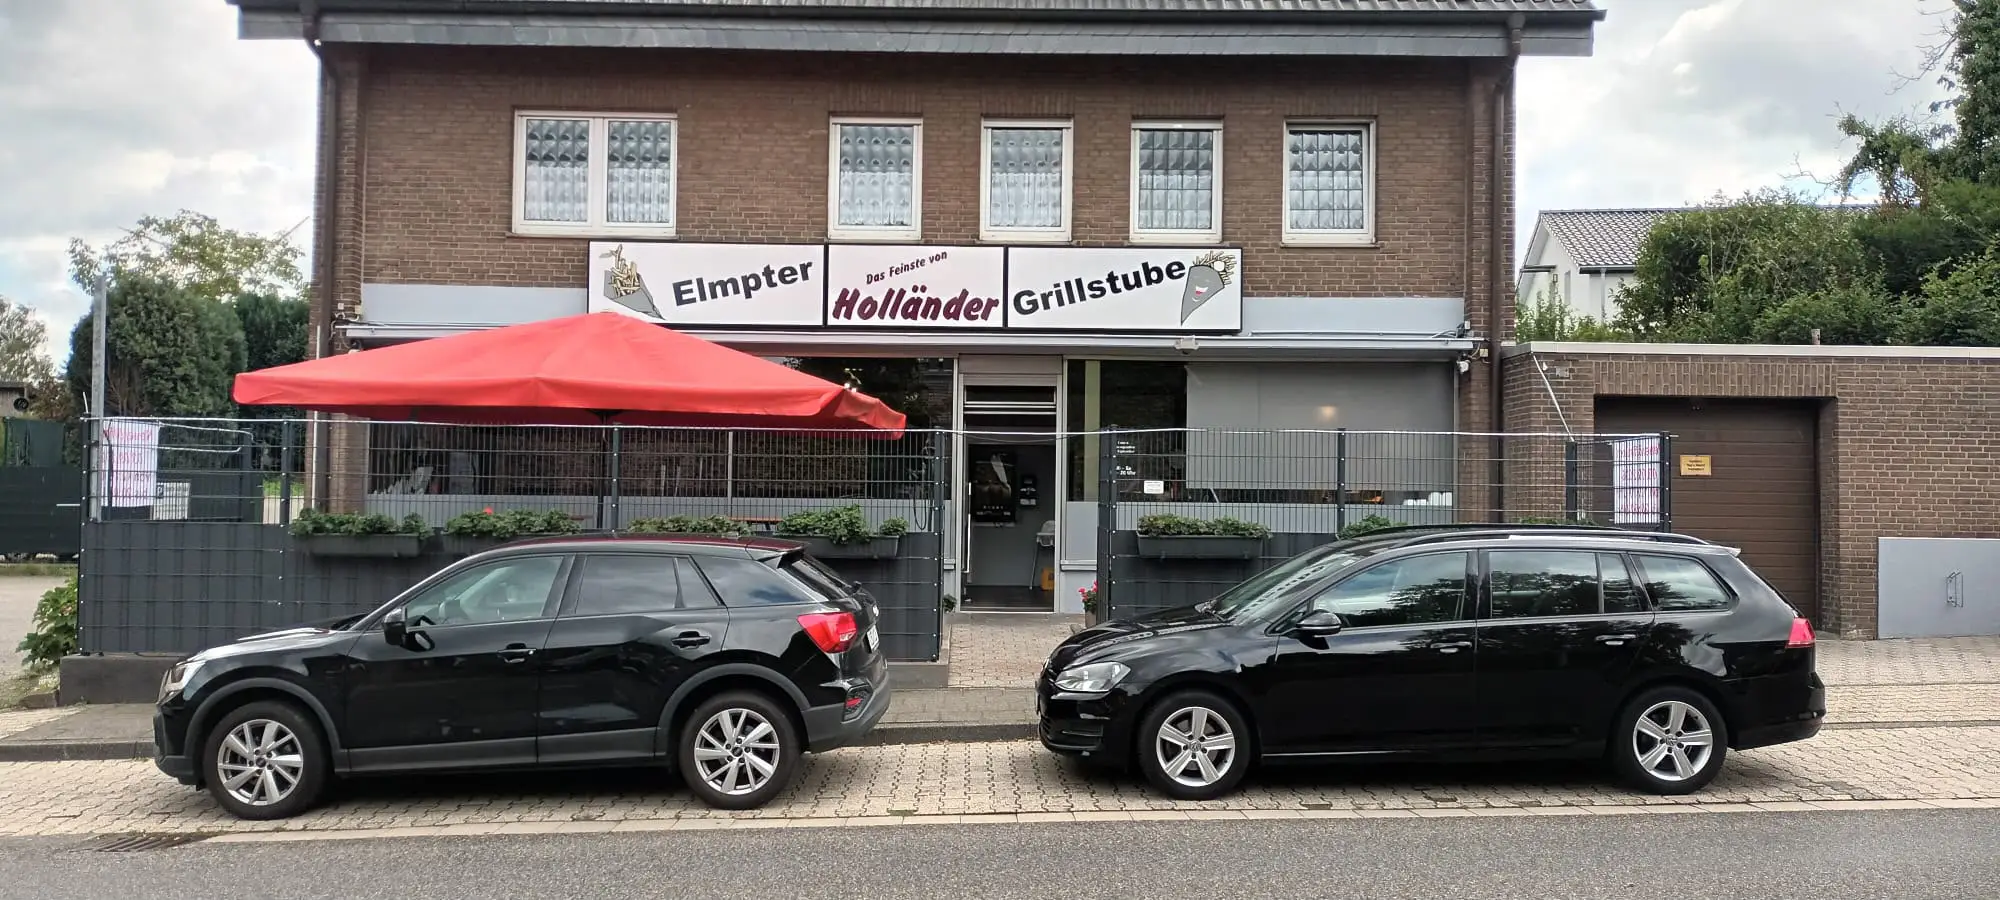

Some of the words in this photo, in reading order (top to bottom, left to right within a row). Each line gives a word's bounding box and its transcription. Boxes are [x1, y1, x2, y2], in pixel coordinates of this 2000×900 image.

[672, 261, 813, 307] Elmpter
[866, 272, 886, 285] Das
[889, 258, 926, 278] Feinste
[928, 251, 949, 264] von
[1013, 260, 1186, 316] Grillstube
[832, 284, 1000, 321] Holländer
